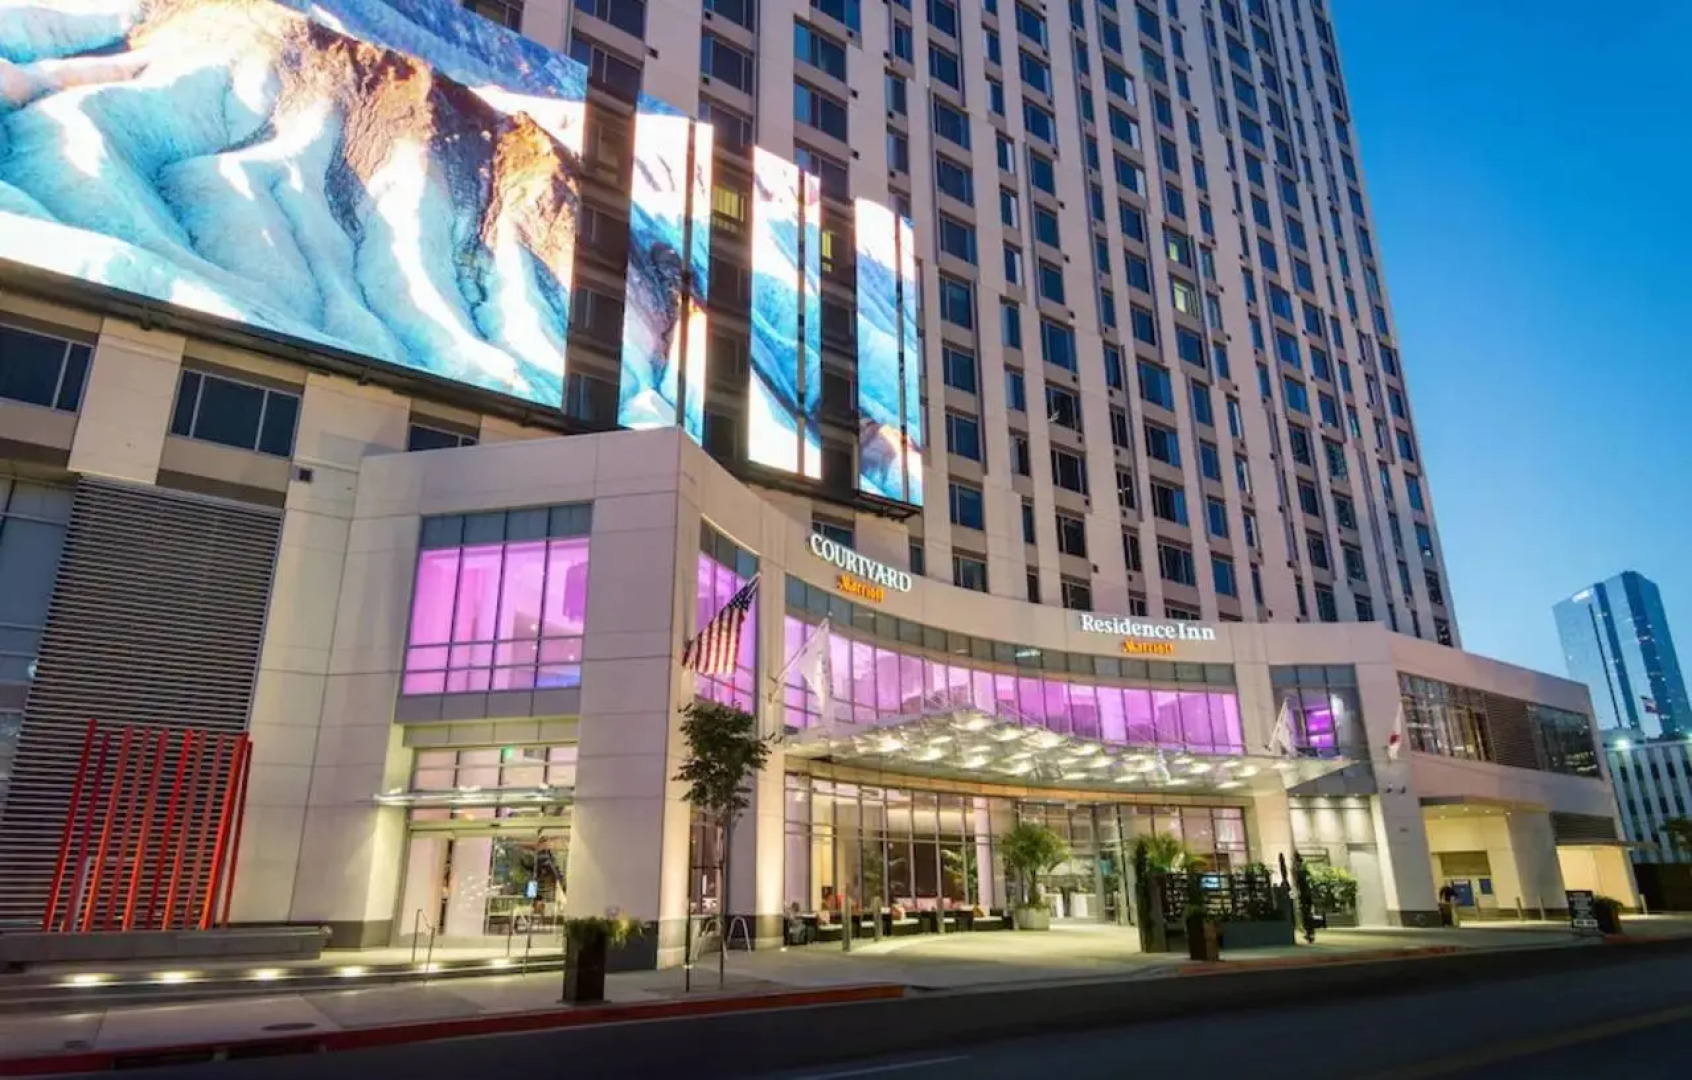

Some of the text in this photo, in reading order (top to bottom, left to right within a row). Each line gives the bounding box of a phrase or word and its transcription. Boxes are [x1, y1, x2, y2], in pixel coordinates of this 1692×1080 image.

[810, 533, 912, 592] COURTYARD
[1081, 614, 1216, 640] Residence Inn
